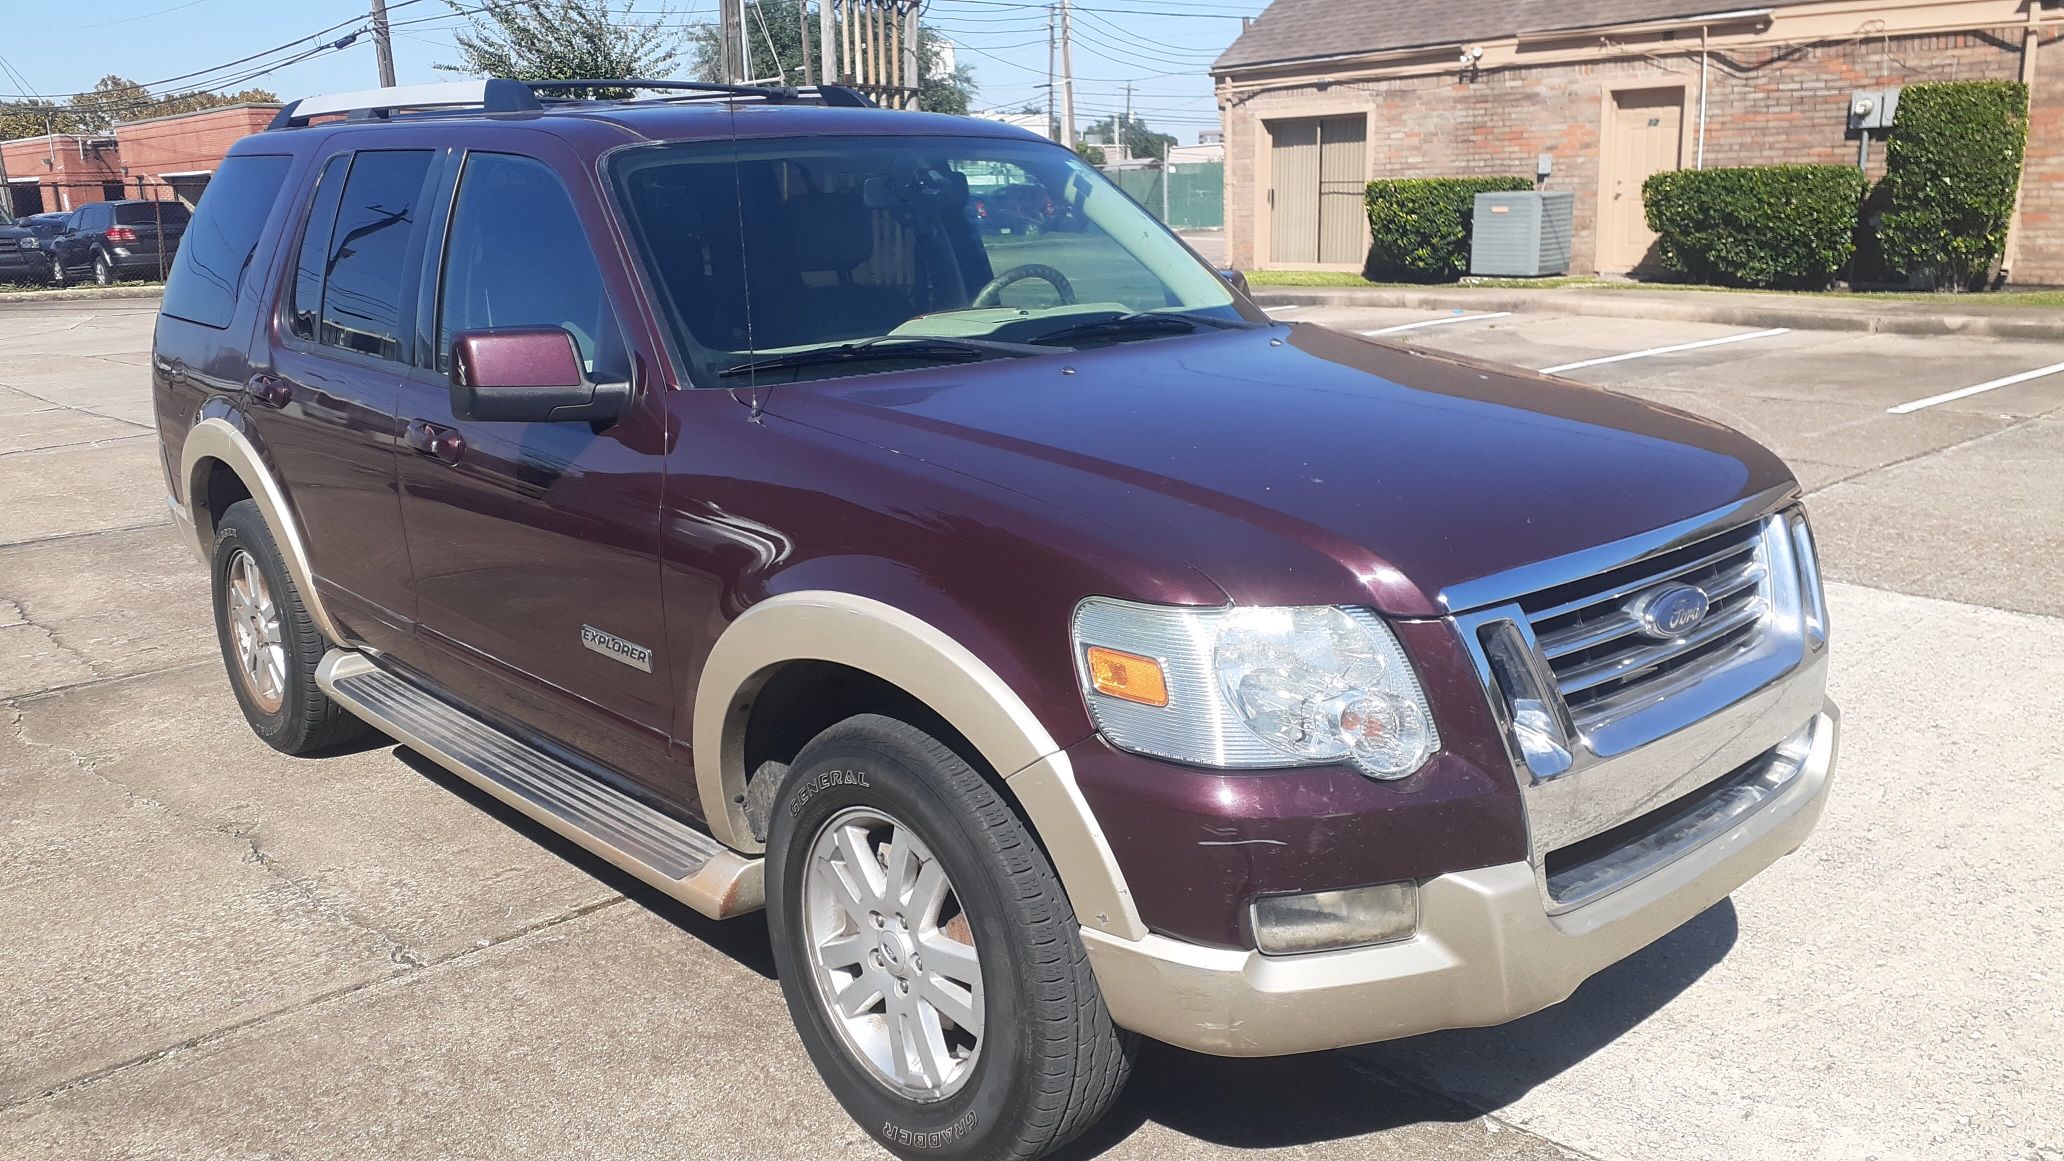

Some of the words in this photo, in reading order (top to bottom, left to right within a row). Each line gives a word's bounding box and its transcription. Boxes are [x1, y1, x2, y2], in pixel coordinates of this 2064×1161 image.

[1669, 599, 1700, 629] Ford
[582, 628, 647, 663] EXPLORER
[789, 769, 870, 817] GENERAL
[882, 1109, 978, 1149] GRABBER
